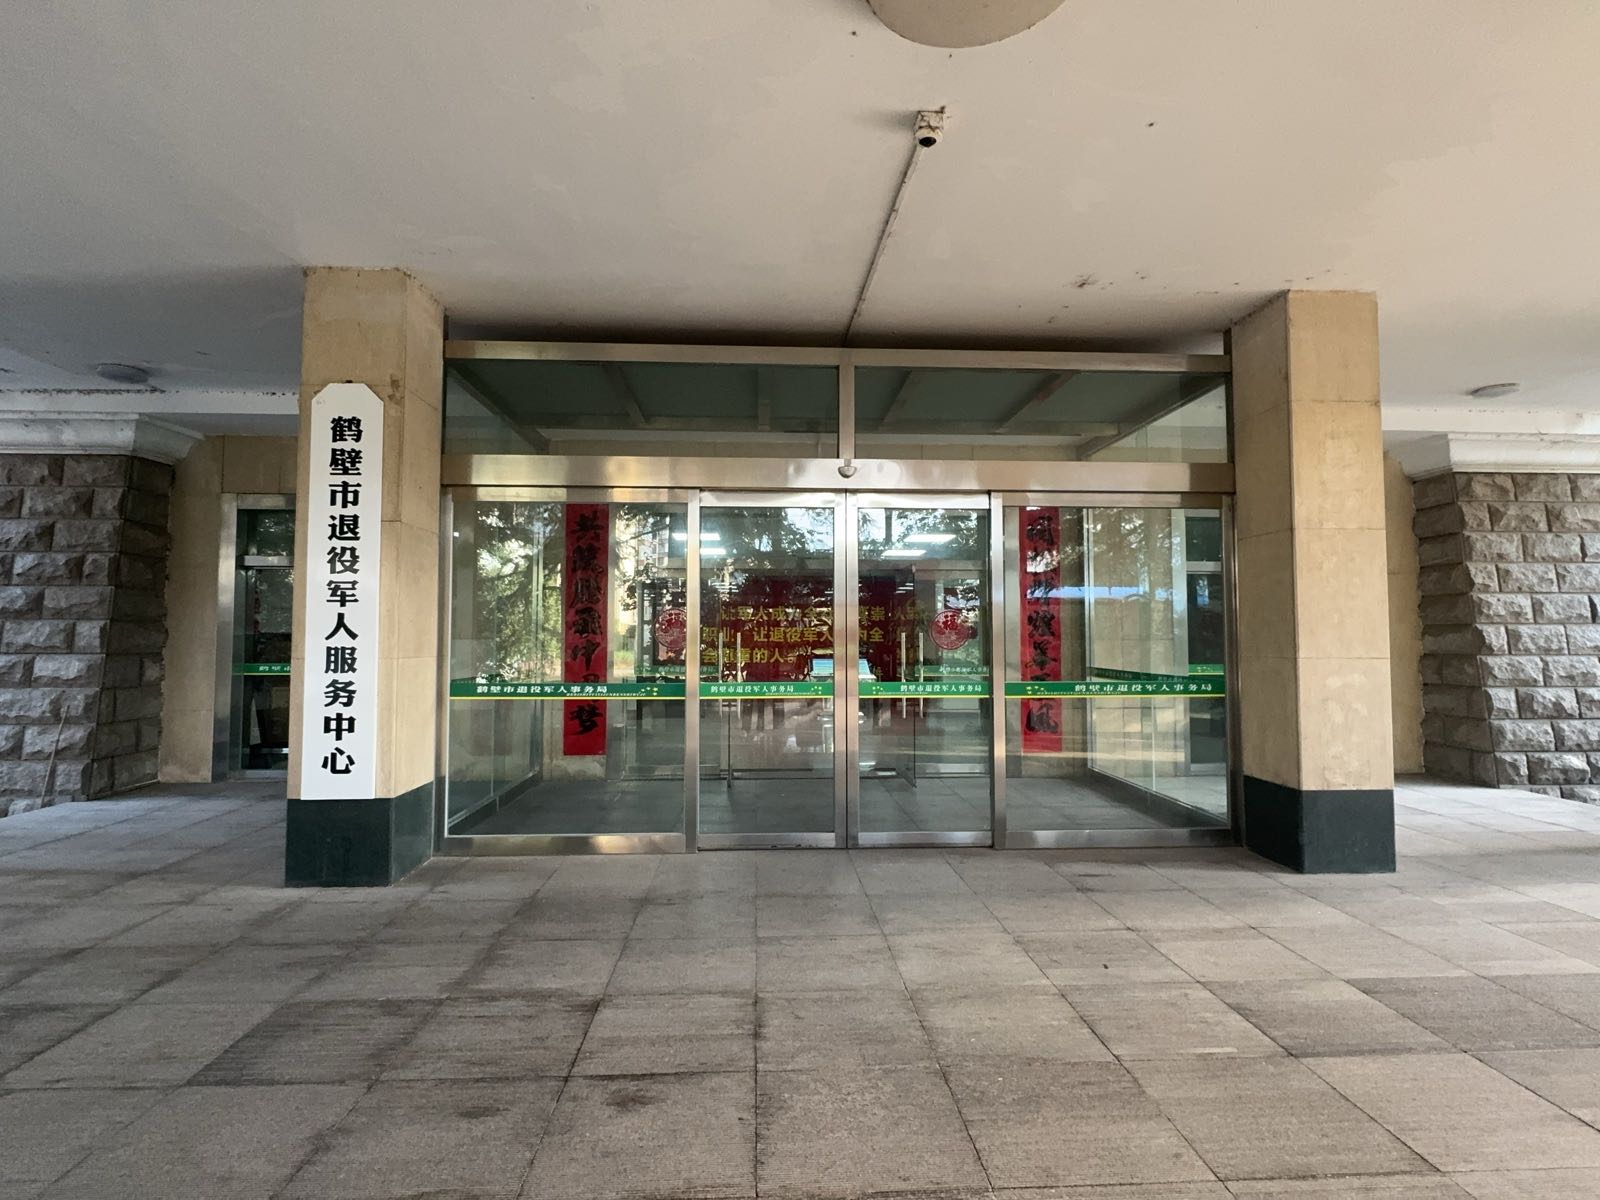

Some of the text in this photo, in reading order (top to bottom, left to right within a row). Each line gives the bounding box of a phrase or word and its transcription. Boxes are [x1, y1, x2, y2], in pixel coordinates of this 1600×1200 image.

[321, 416, 364, 775] 鹤壁市退役军人服务中心
[476, 685, 608, 694] 鹤壁市退役军人事务局
[710, 685, 794, 693] 鹤壁市退役军人事务局
[900, 684, 982, 692] 鹤壁市退役军人事务局
[1074, 684, 1212, 693] 鹤壁市退役军人事务局
